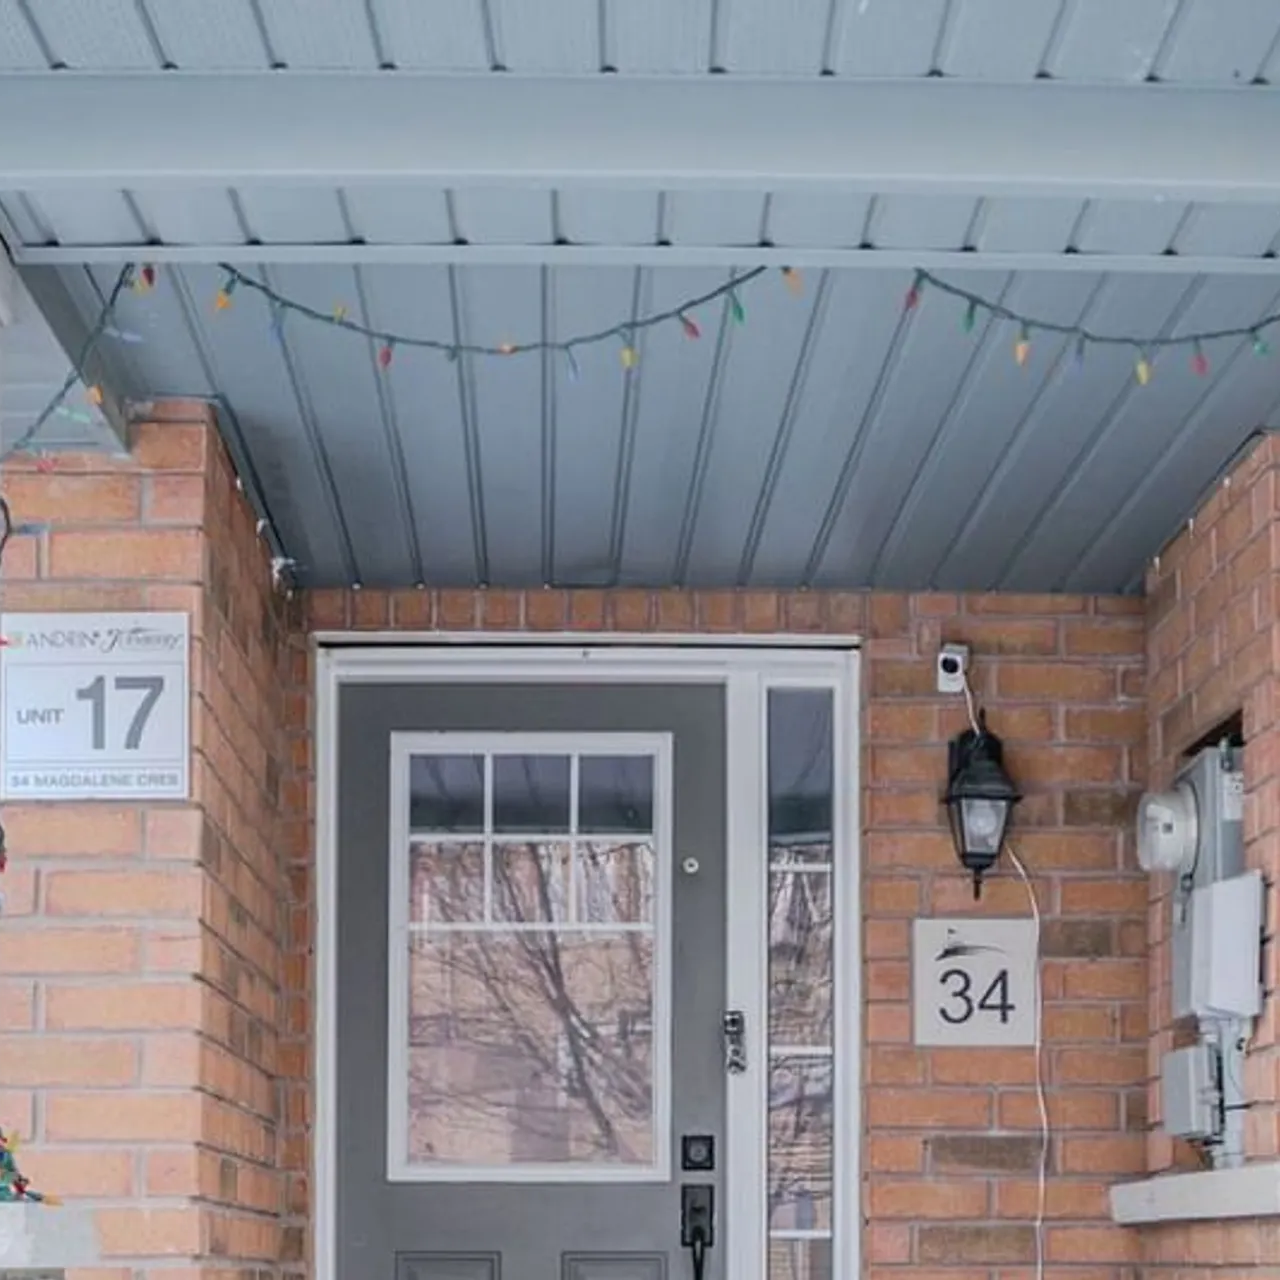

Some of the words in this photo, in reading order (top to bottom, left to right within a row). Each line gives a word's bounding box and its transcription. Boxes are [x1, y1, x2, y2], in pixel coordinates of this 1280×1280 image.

[16, 708, 64, 725] UNIT
[75, 675, 165, 751] 17
[939, 968, 1016, 1024] 34
